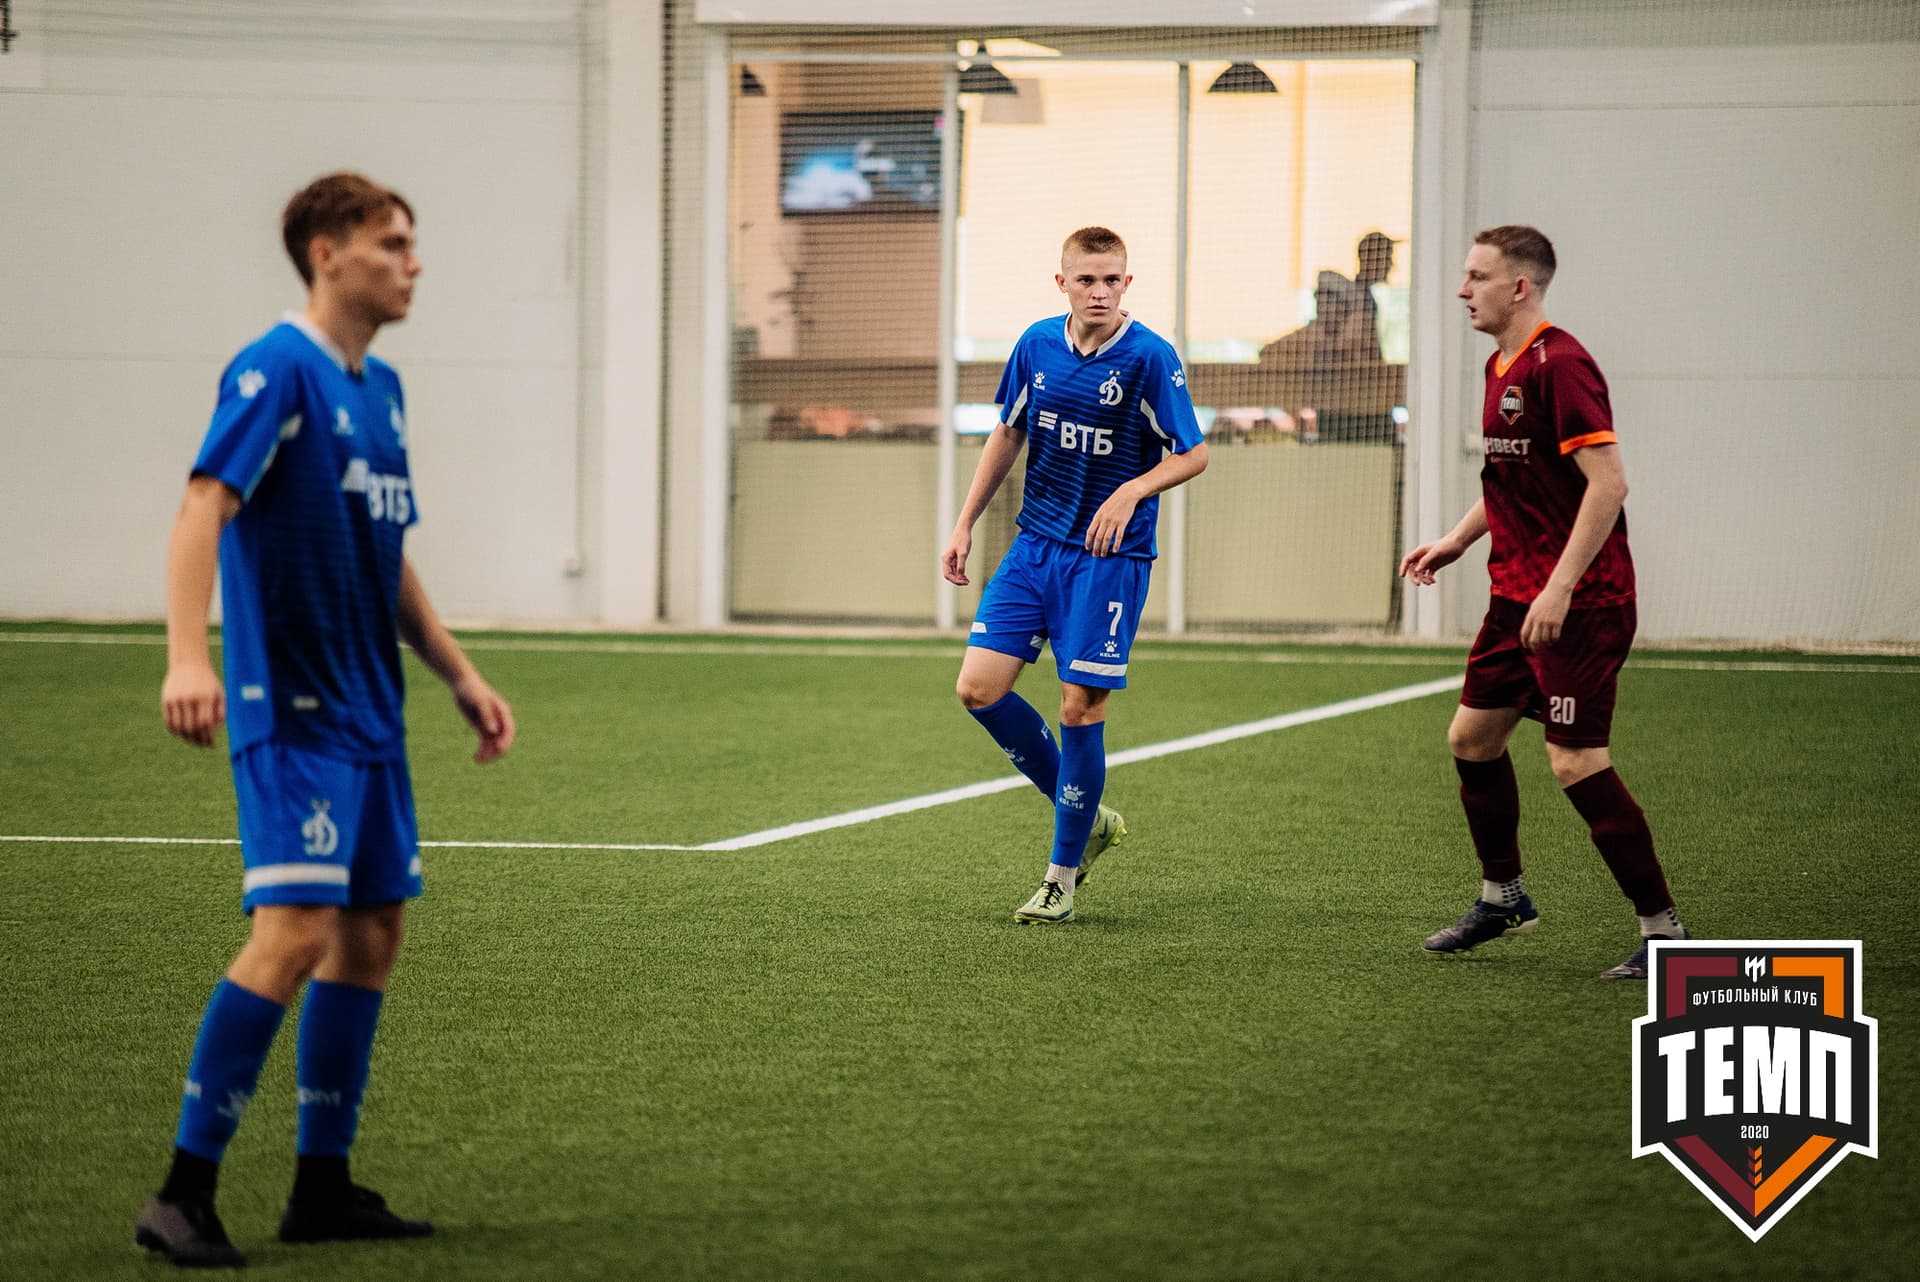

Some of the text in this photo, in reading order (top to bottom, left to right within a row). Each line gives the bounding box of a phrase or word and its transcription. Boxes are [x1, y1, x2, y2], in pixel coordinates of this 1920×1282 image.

[1060, 421, 1114, 456] ВТБ
[1107, 601, 1123, 636] 7
[1549, 696, 1576, 725] 20
